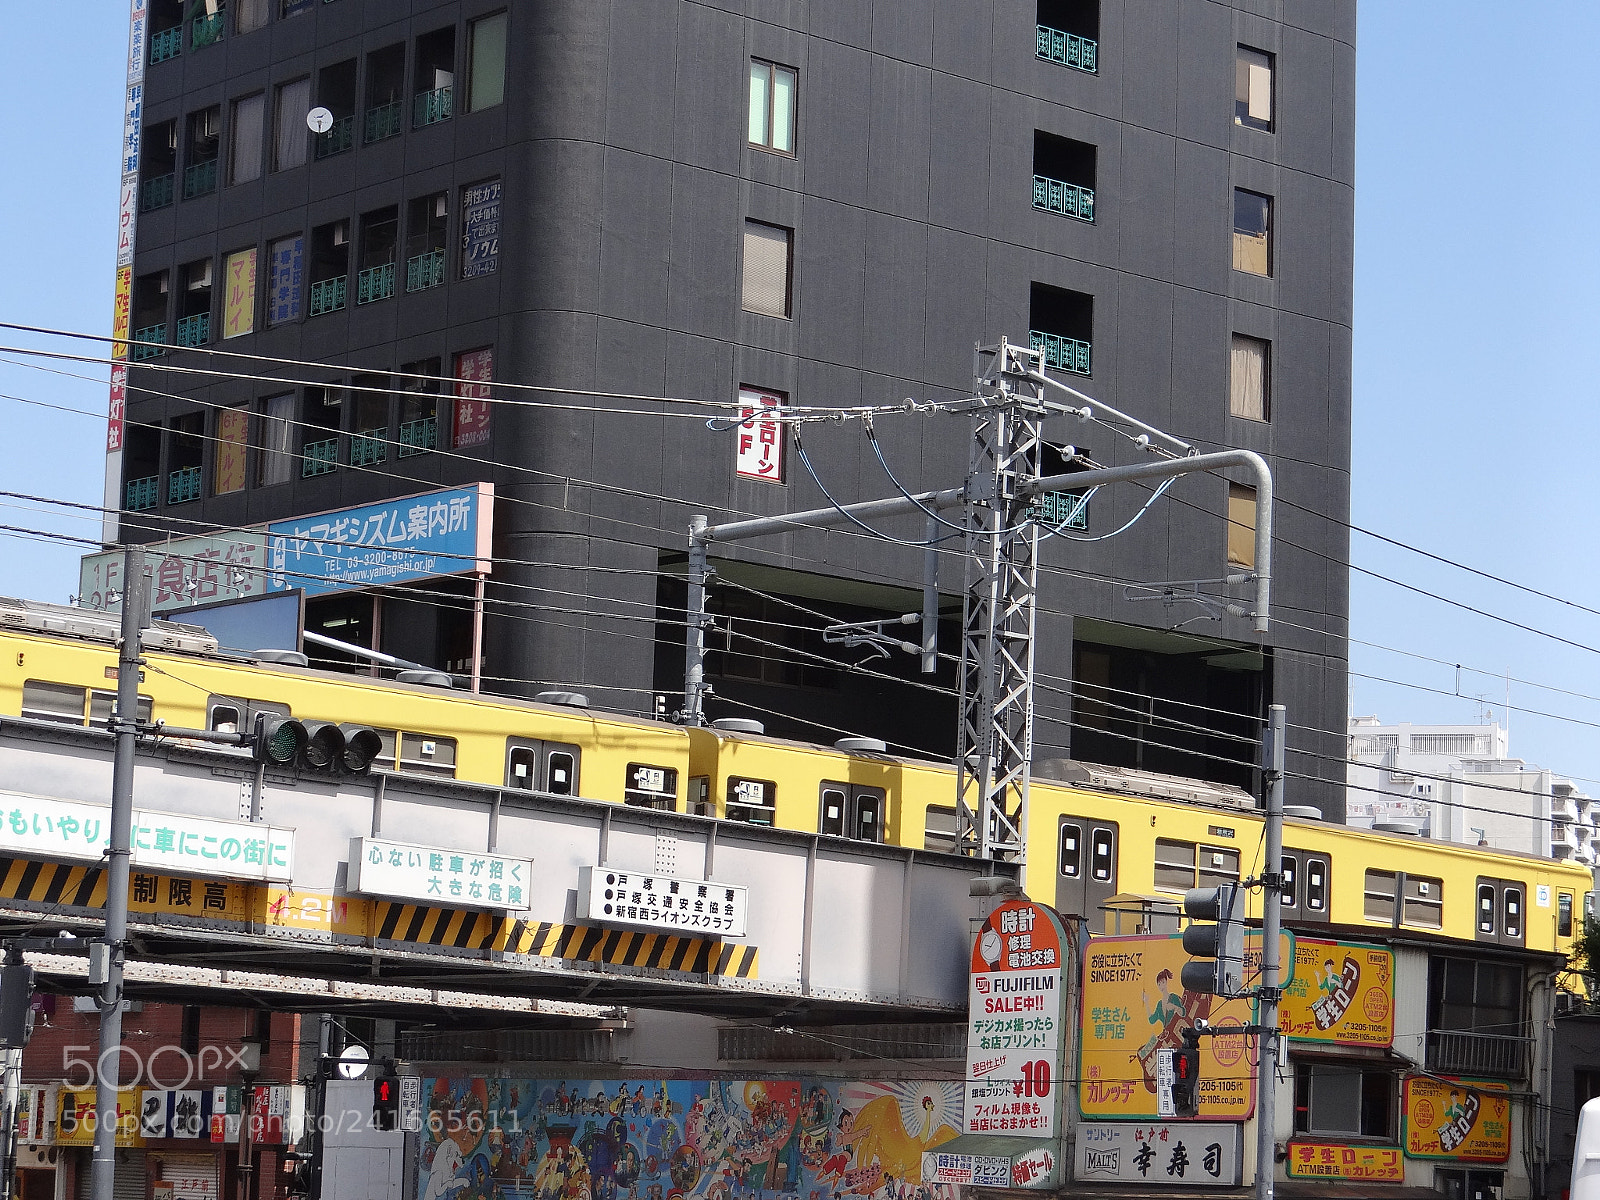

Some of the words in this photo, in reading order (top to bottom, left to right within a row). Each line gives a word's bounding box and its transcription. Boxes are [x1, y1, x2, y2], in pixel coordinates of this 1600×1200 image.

[120, 189, 131, 249] ノウム
[470, 239, 499, 260] ノウム
[230, 260, 244, 331] マルイ
[325, 559, 342, 573] TEL
[368, 845, 522, 883] 心ない駐車が招く
[427, 875, 523, 905] 大きな危険
[616, 889, 735, 917] 戸塚交通安全協会
[615, 904, 735, 931] 新宿西ライオンズクラブ
[1001, 907, 1036, 934] 時計
[1007, 934, 1032, 952] 修理
[1008, 948, 1056, 968] 電池交換
[1091, 953, 1143, 969] お役に立ちたくて
[993, 975, 1055, 993] FUJIFILM
[1091, 1007, 1131, 1023] 学生さん
[974, 1016, 1054, 1034] デジカメ撮ったら
[1094, 1023, 1126, 1040] 専門店
[974, 1102, 1041, 1117] フィルム現像も
[1086, 1129, 1120, 1141] サントリー
[938, 1154, 960, 1168] 時計
[1087, 1151, 1118, 1169] MALT'S
[1298, 1146, 1398, 1167] 学生ローン
